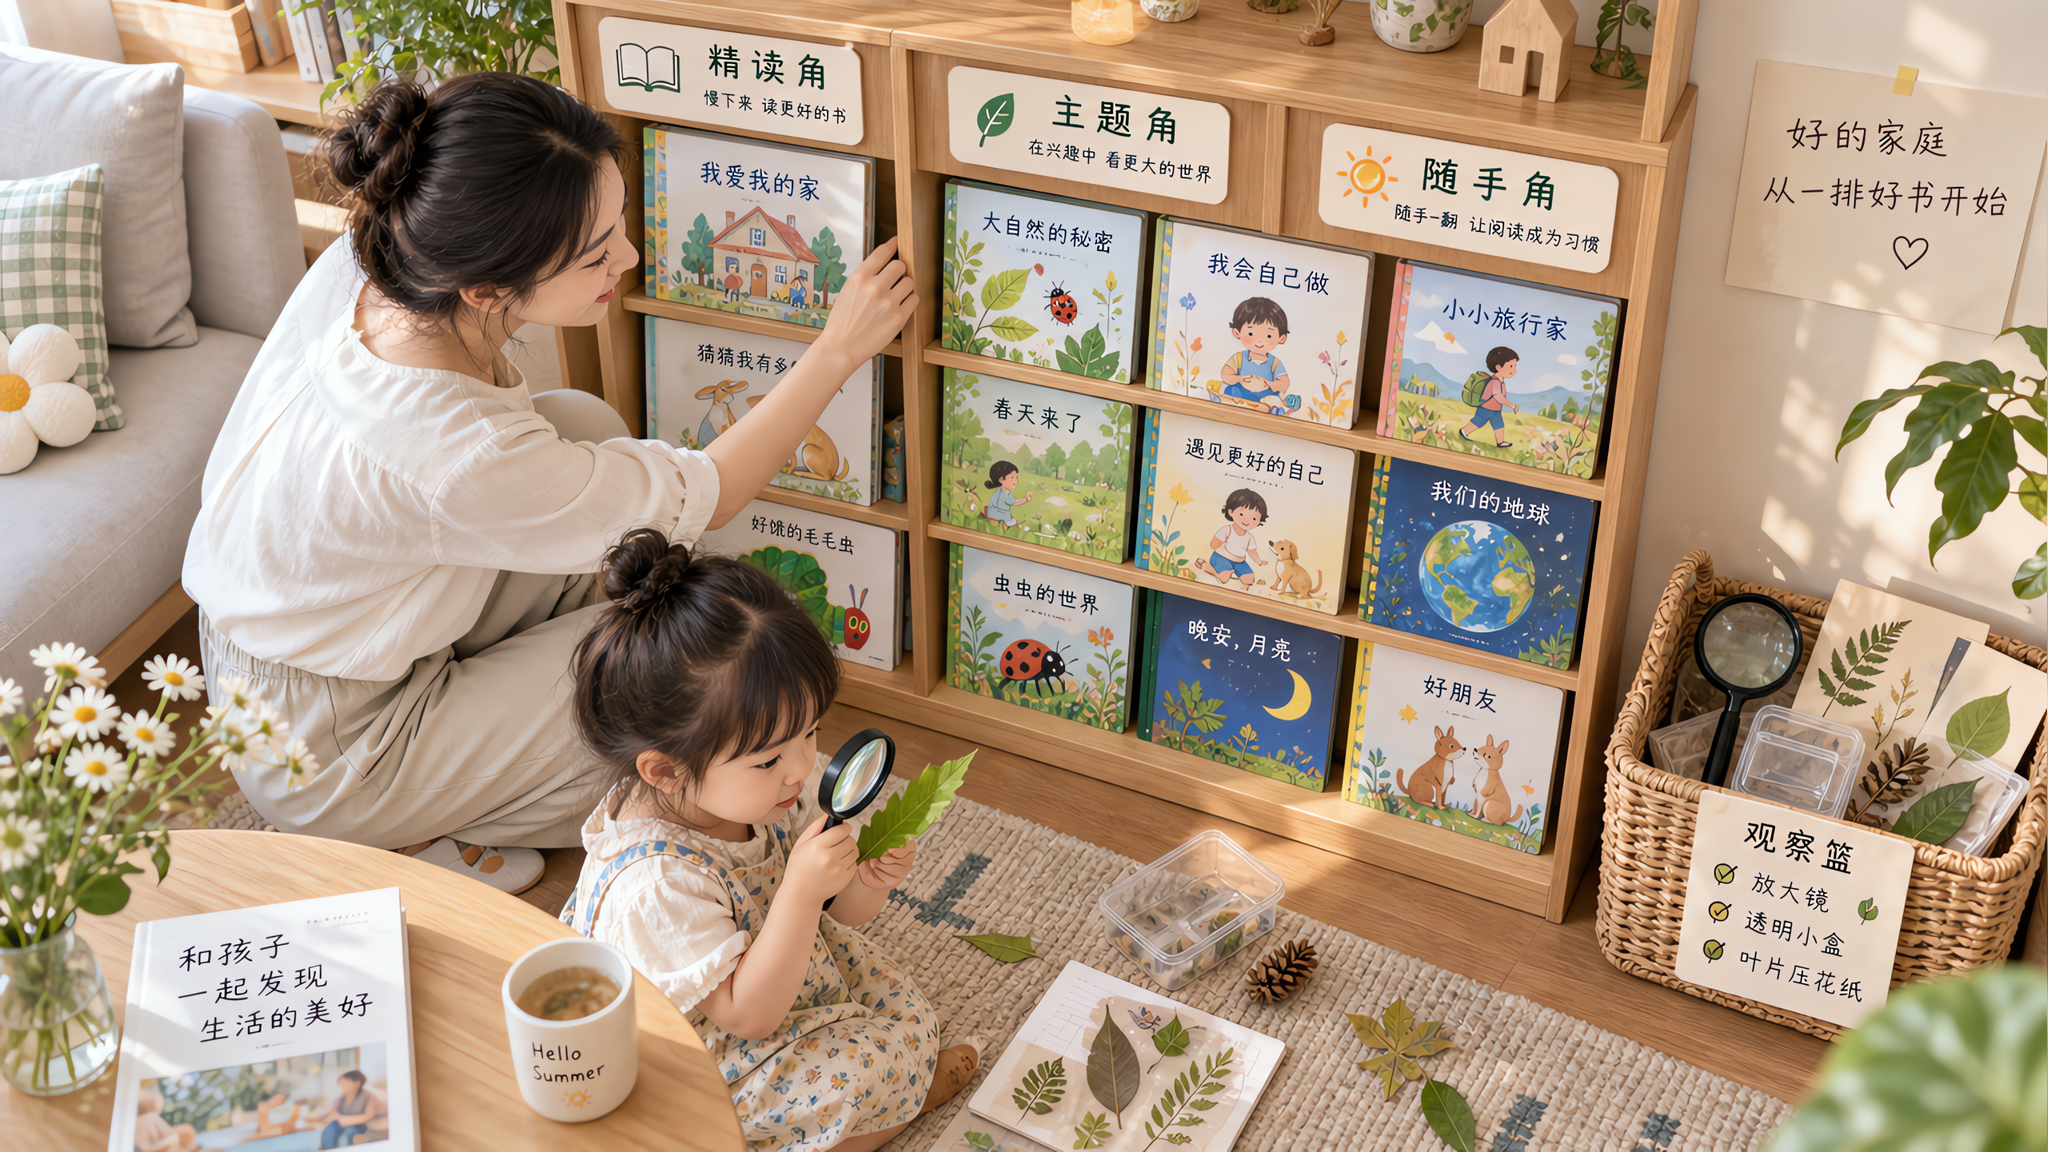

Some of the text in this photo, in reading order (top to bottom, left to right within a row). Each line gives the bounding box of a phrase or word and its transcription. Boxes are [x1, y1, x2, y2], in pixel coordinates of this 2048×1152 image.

[708, 44, 826, 90] 精读角
[703, 90, 846, 124] 慢下来 读更好的书
[1052, 94, 1177, 145] 主题角
[1786, 118, 1947, 157] 好的家庭
[700, 161, 820, 201] 我爱我的家
[1028, 138, 1212, 184] 在兴趣中 看更大的世界
[1422, 158, 1555, 210] 随手角
[1763, 177, 2008, 216] 从一排好书开始
[982, 211, 1113, 254] 大自然的秘密
[1394, 204, 1600, 254] 随手一翻 让阅读成为习惯
[1208, 253, 1329, 295] 我会自己做
[1443, 298, 1568, 341] 小小旅行家
[697, 344, 797, 375] 猜猜我有多
[992, 398, 1081, 434] 春天来了
[1185, 438, 1324, 485] 遇见更好的自己
[1430, 479, 1550, 525] 我们的地球
[993, 573, 1099, 615] 虫虫的世界
[1423, 675, 1497, 713] 好朋友
[1744, 822, 1854, 874] 观察篮
[1751, 872, 1829, 913] 放大镜
[178, 934, 290, 971] 和孩子
[1744, 910, 1845, 957] 透明小盒
[178, 964, 328, 1004] 一起发现
[1740, 951, 1863, 1003] 叶片压花纸
[200, 993, 373, 1043] 生活的美好
[532, 1041, 582, 1061] Hello
[533, 1064, 605, 1083] Summer
